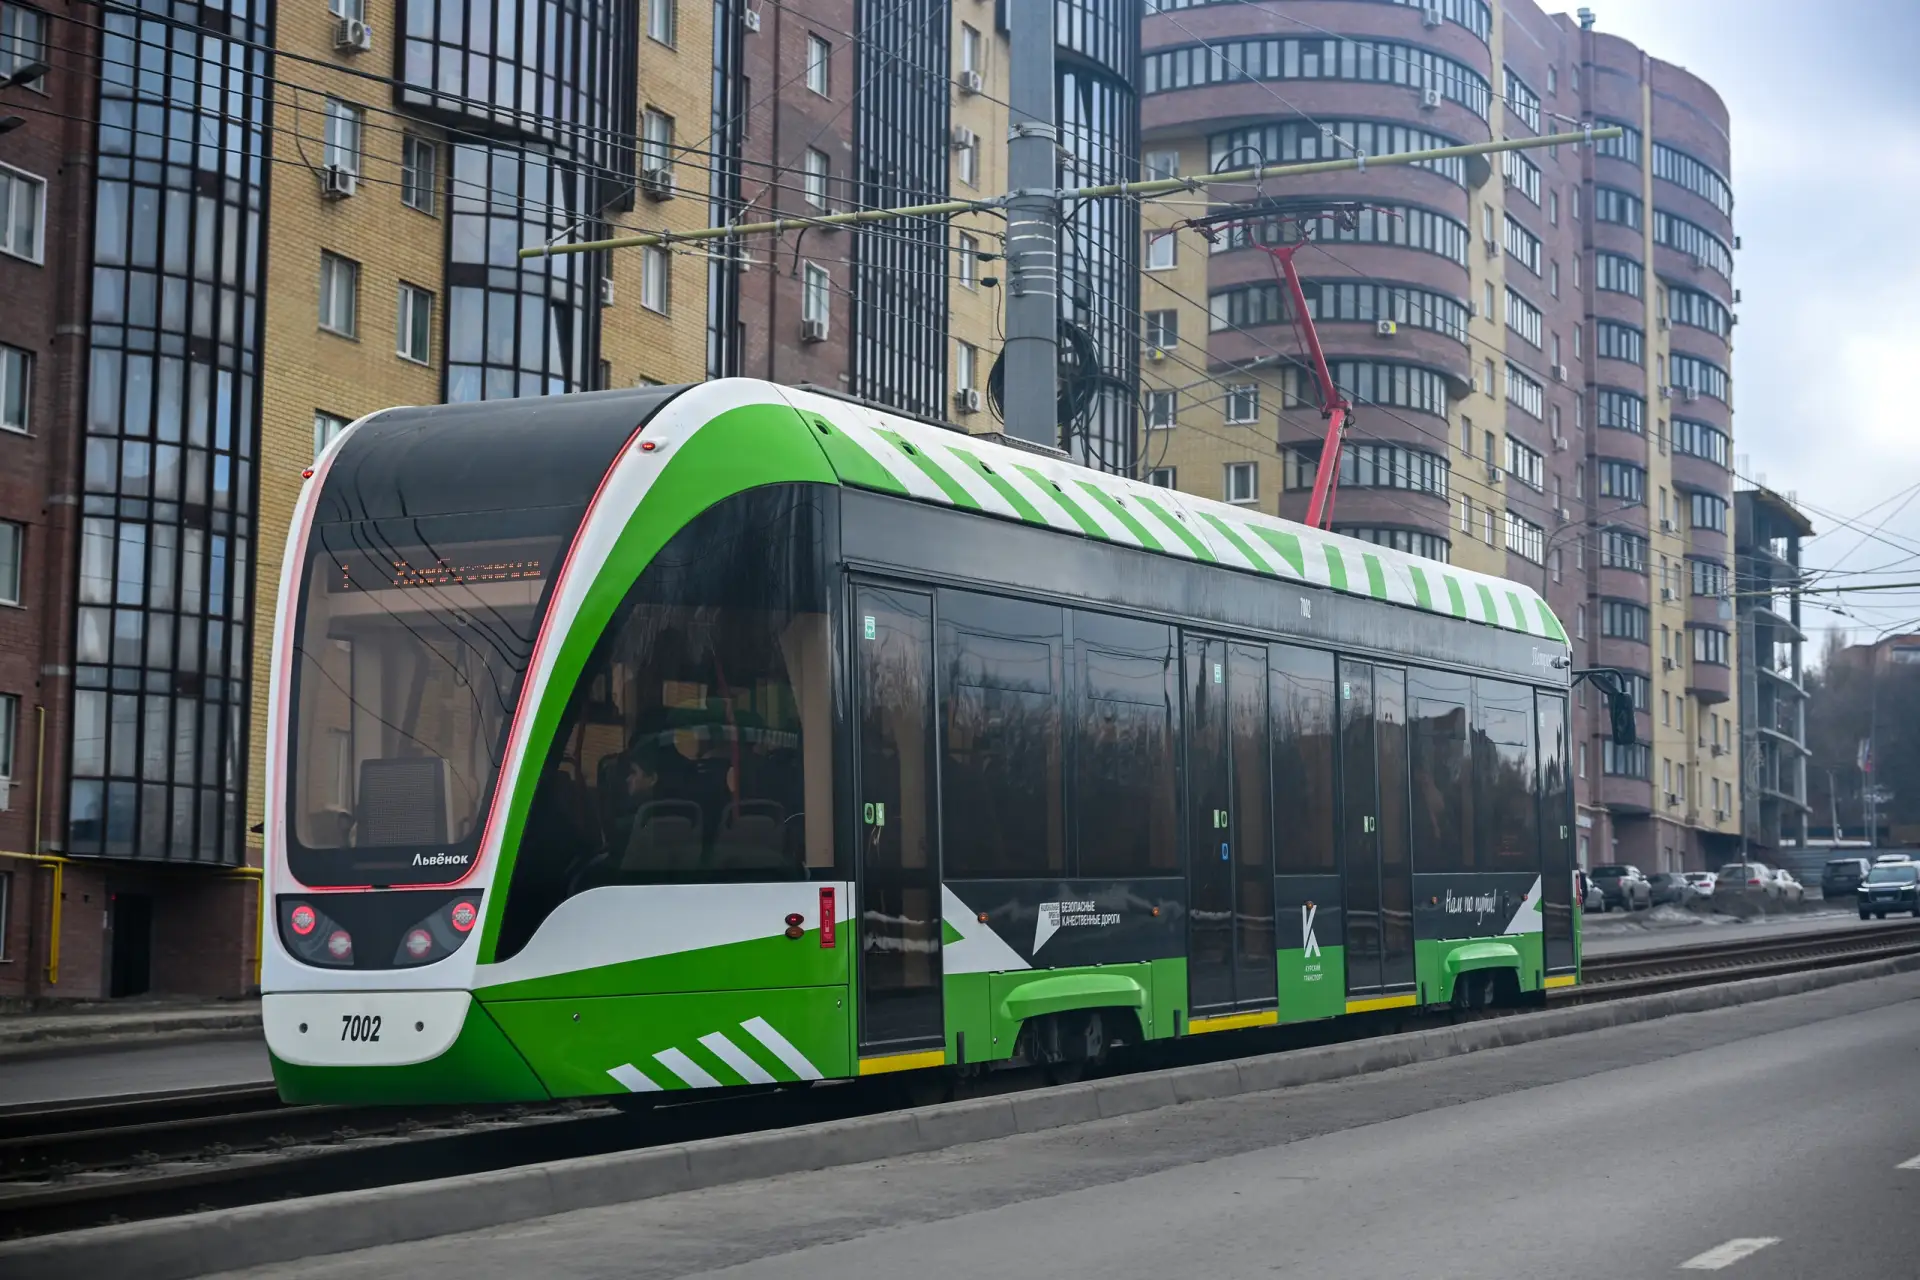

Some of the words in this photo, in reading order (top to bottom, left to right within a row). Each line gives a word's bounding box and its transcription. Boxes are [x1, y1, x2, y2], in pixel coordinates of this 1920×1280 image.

[412, 852, 468, 866] Львёнок
[1061, 901, 1095, 913] БЕЗОПАСНЫЕ
[1464, 896, 1474, 913] по
[1061, 914, 1101, 927] КАЧЕСТВЕННЫЕ
[1101, 913, 1121, 927] ДОРОГИ
[341, 1014, 382, 1042] 7002
